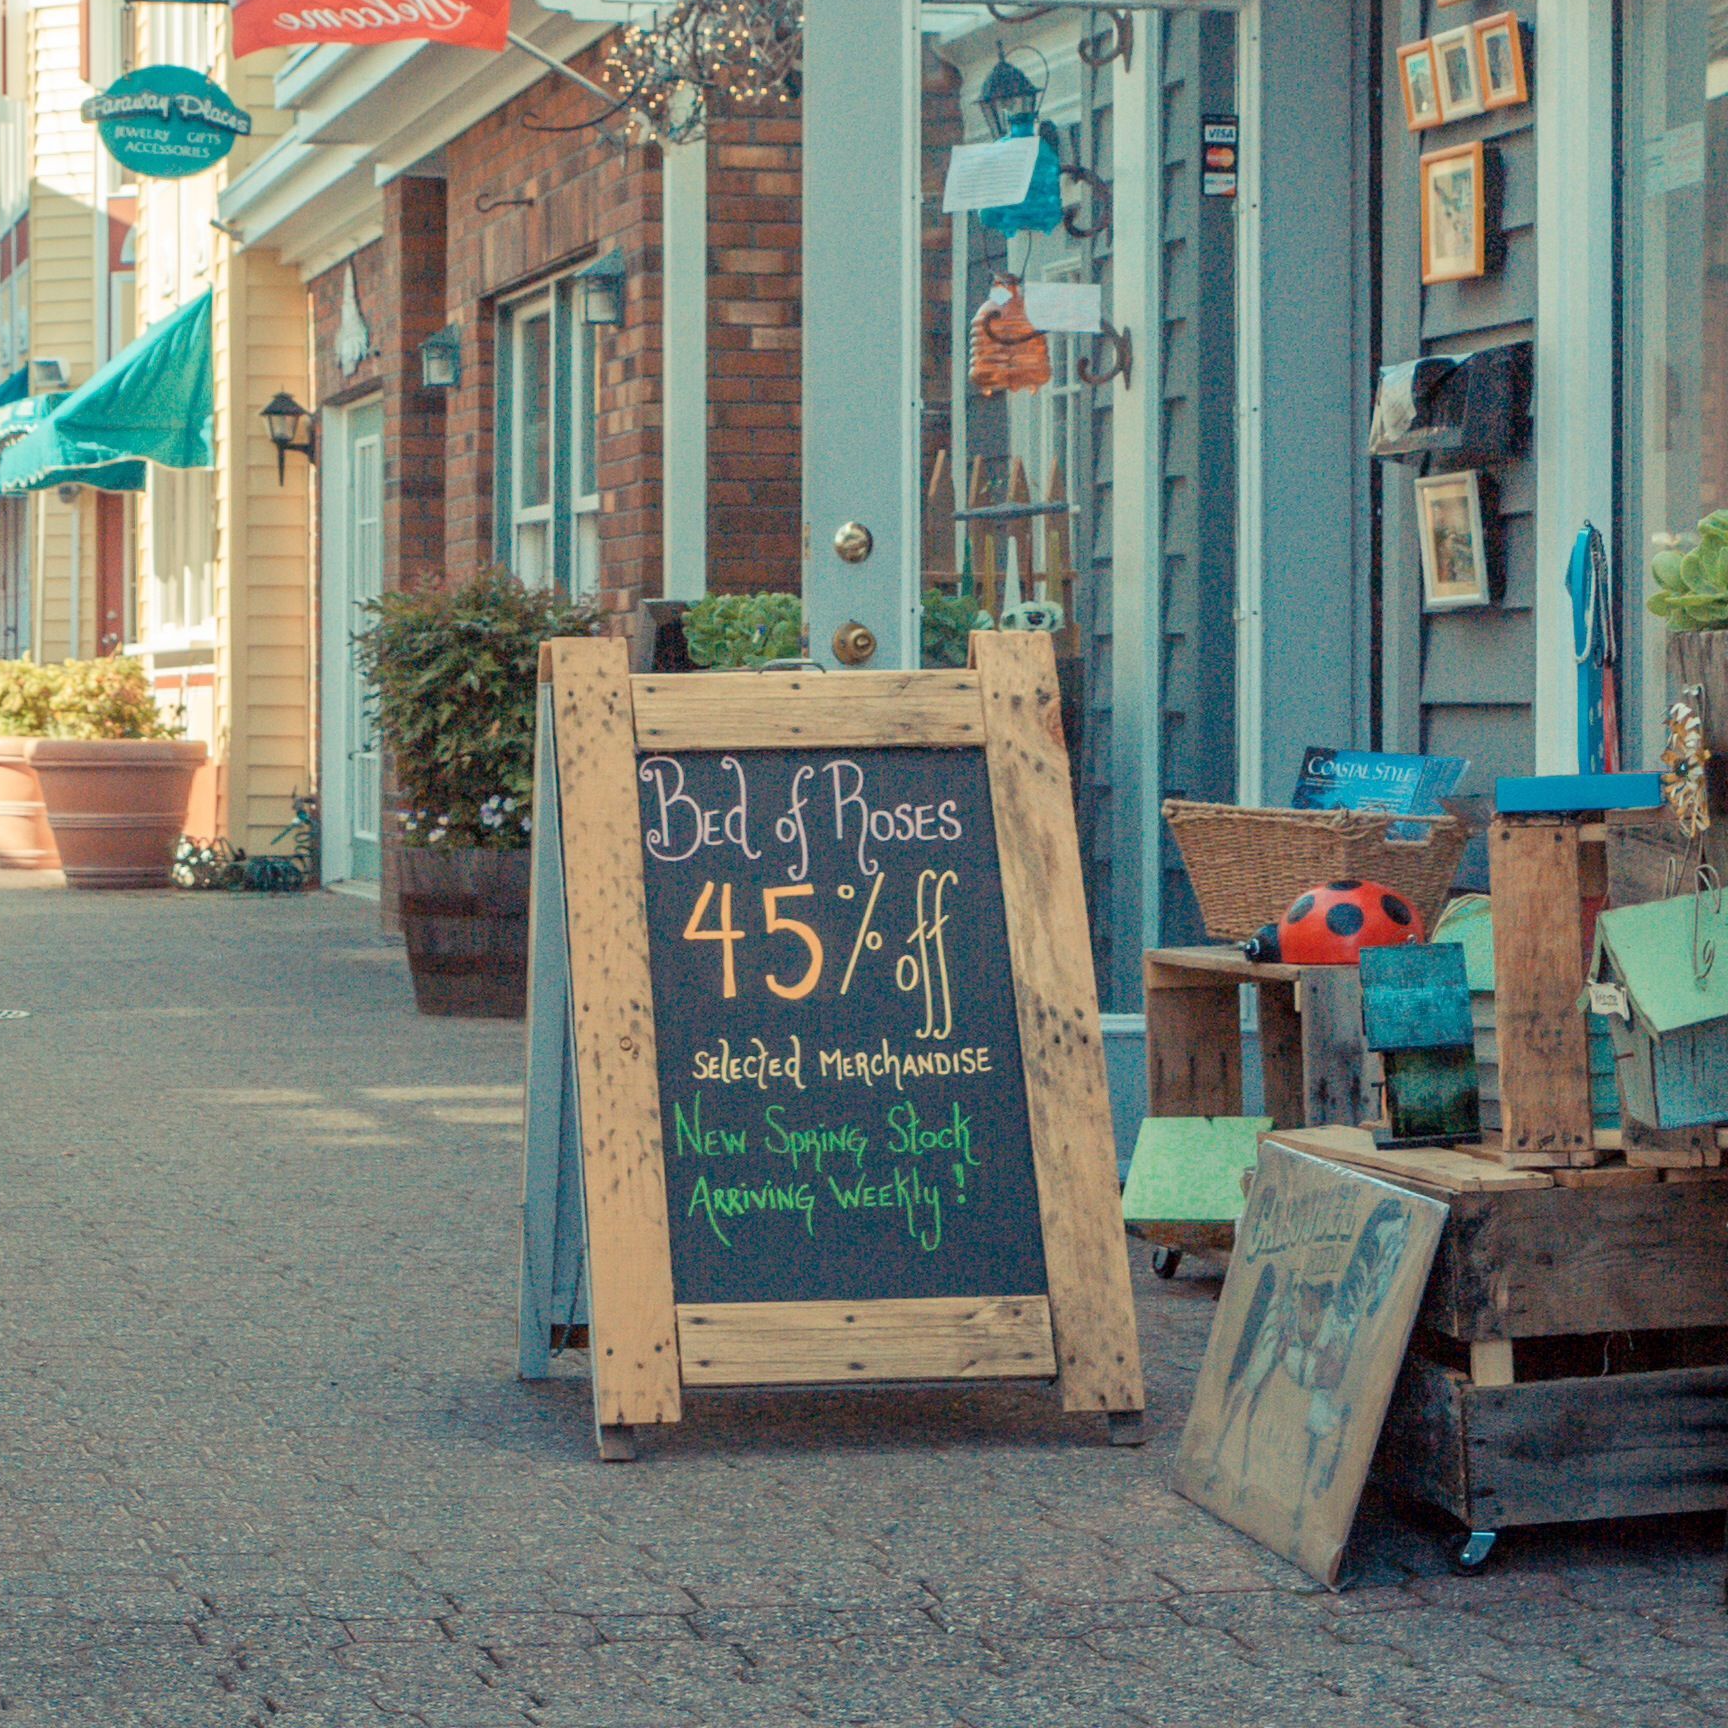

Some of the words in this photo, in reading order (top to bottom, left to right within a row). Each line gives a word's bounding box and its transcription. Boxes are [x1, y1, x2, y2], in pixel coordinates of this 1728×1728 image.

[90, 91, 171, 118] Faraway
[175, 94, 250, 133] Places
[115, 127, 170, 142] JEWELRY
[187, 131, 221, 145] GIFTS
[1208, 128, 1234, 139] VISA
[125, 141, 211, 159] ACCESSORIES
[1307, 756, 1370, 780] COASTAL
[1372, 762, 1417, 782] STYLE
[776, 765, 814, 881] of
[683, 872, 883, 1000] 45%
[895, 869, 959, 1039] off
